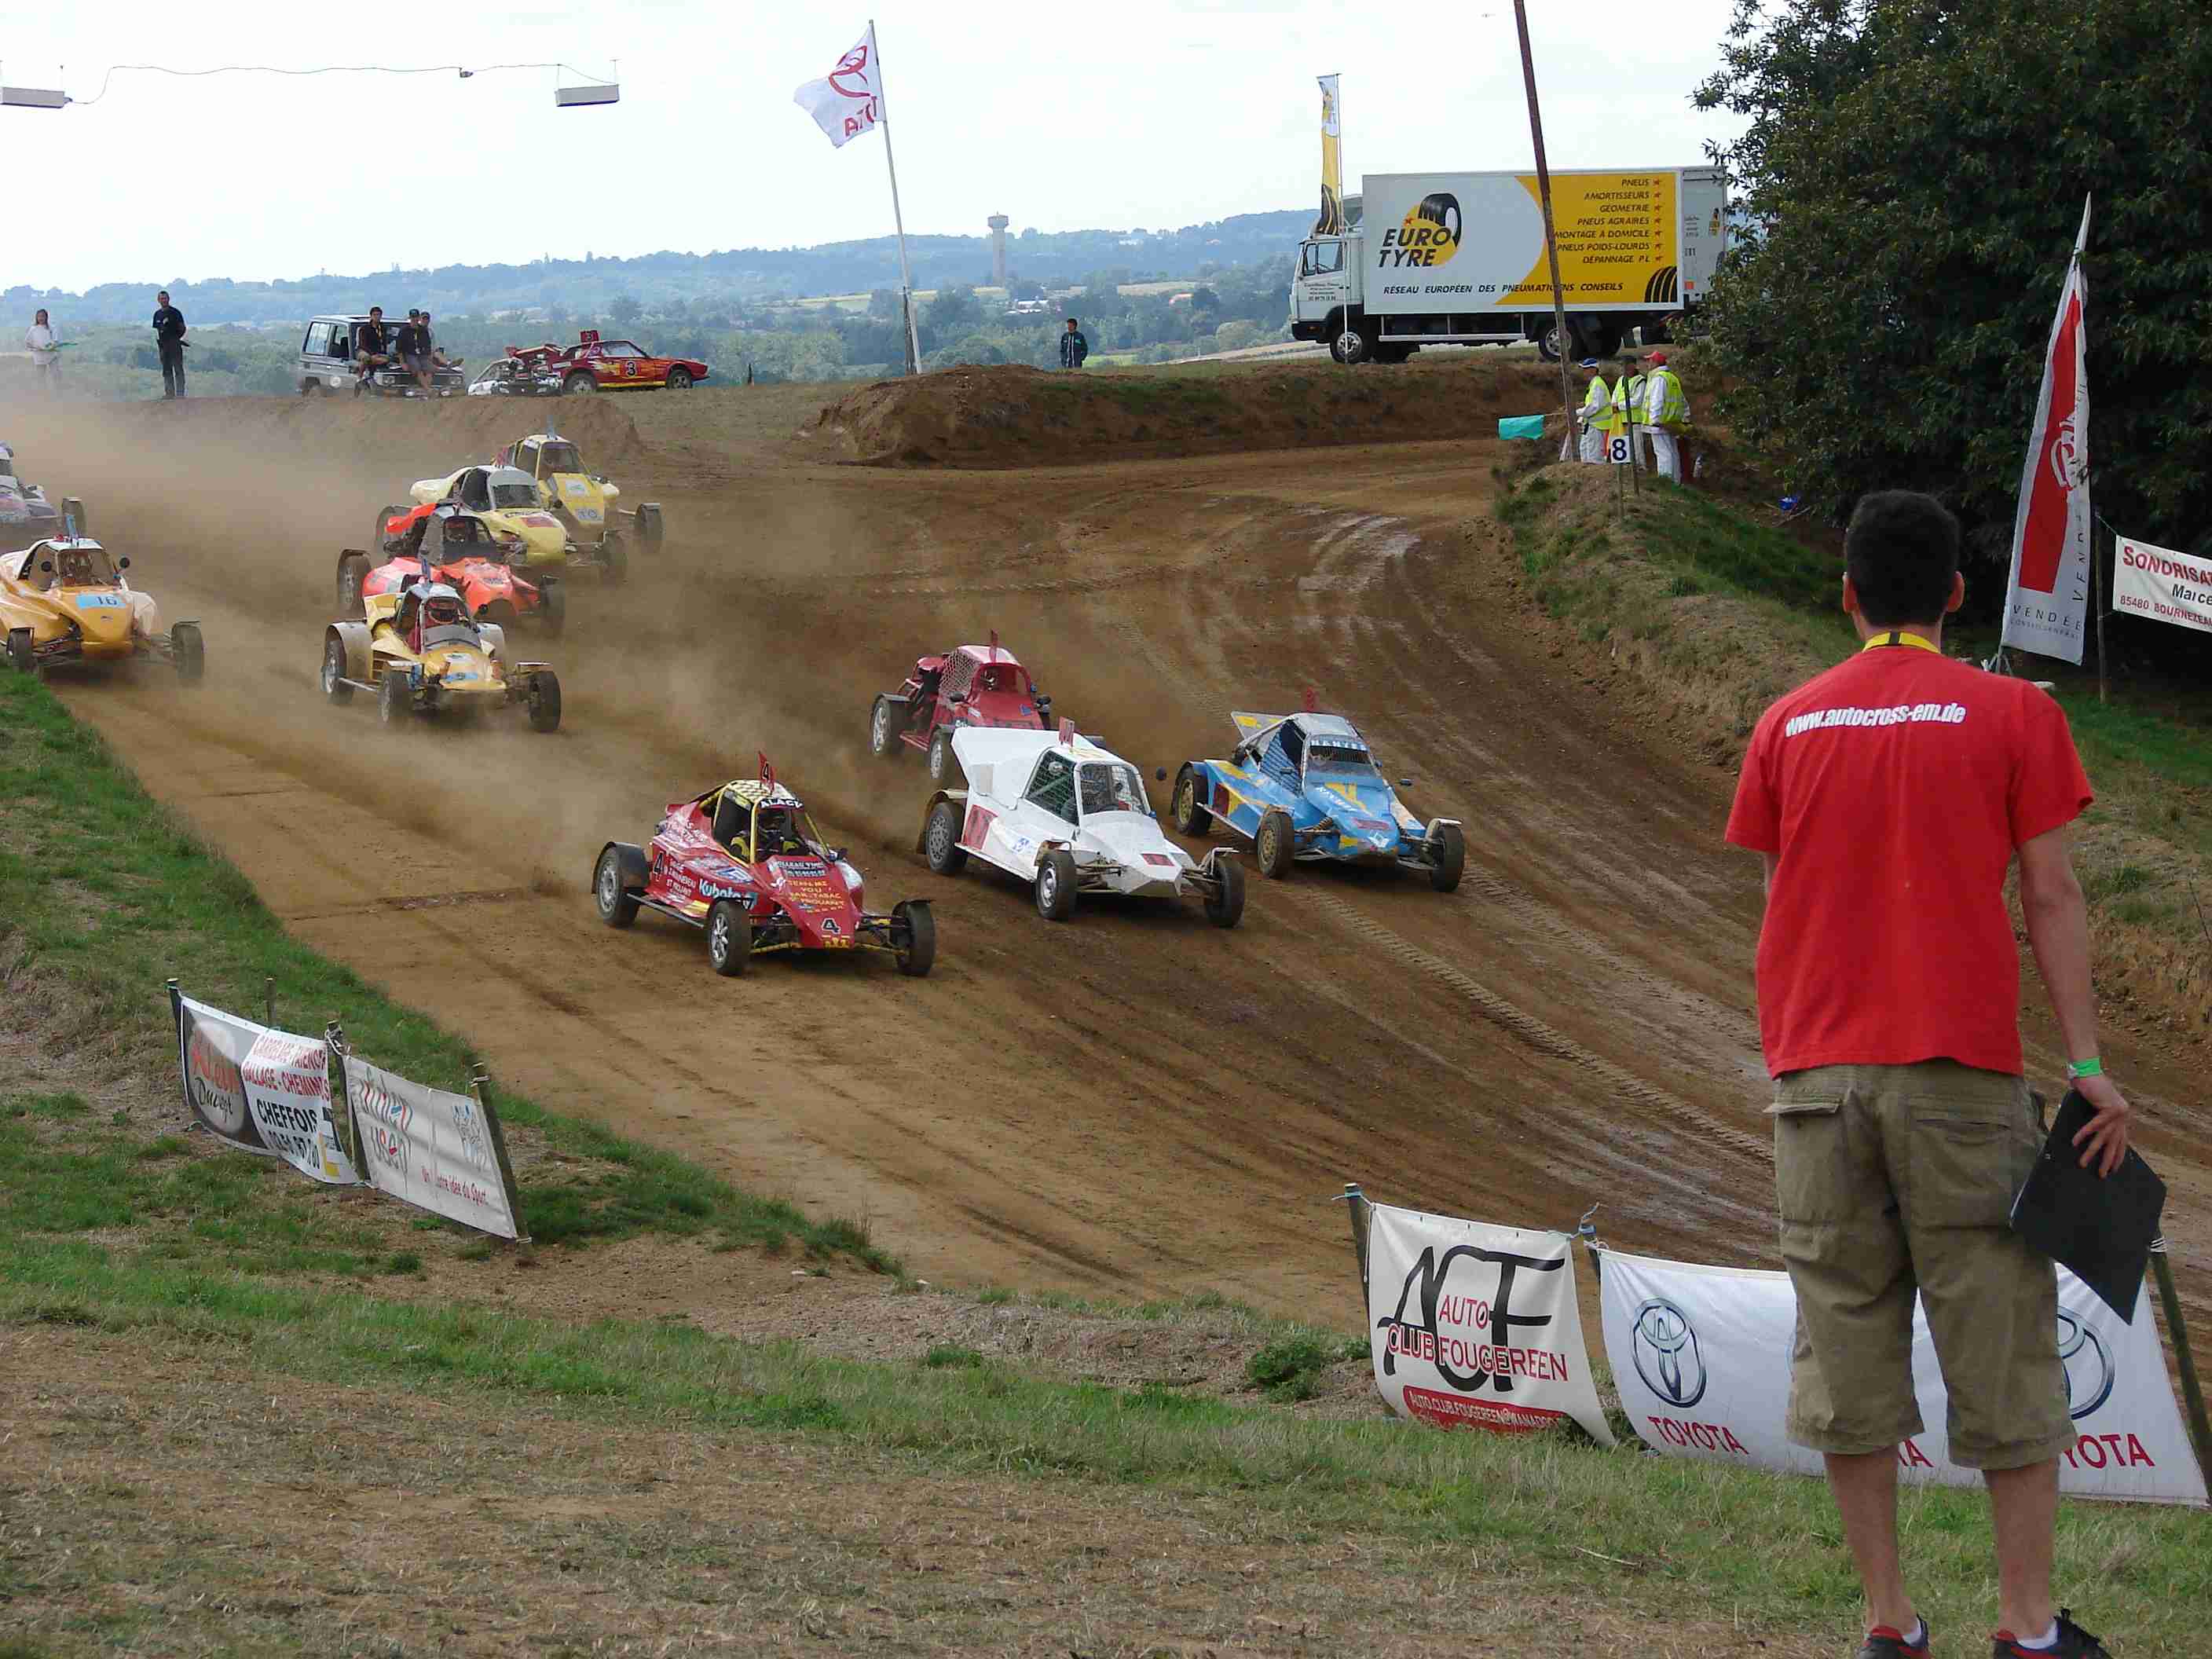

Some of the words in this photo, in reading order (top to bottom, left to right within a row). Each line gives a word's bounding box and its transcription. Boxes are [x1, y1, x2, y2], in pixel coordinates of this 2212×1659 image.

[1621, 178, 1650, 187] PNEUS
[1584, 192, 1650, 200] AMORTISSEURS
[1608, 217, 1650, 225] AGRAIRES
[1382, 228, 1452, 247] EURO
[1608, 229, 1650, 238] DOMICILE
[1557, 243, 1584, 251] PNEUS
[1379, 249, 1437, 267] TYRE
[1478, 284, 1496, 293] DES
[1580, 282, 1624, 291] CONSEILS
[627, 361, 636, 377] 3
[1612, 438, 1628, 461] 8
[762, 761, 770, 780] 4
[653, 850, 664, 874] 4
[822, 917, 841, 935] 4
[257, 1098, 317, 1133] CHEFFOIS
[1438, 1295, 1489, 1330] AUTO
[1387, 1323, 1434, 1362] CLUB
[1437, 1337, 1569, 1382] FOUGEREEN
[1646, 1415, 1749, 1456] TOYOTA
[2064, 1434, 2156, 1470] YOTA
